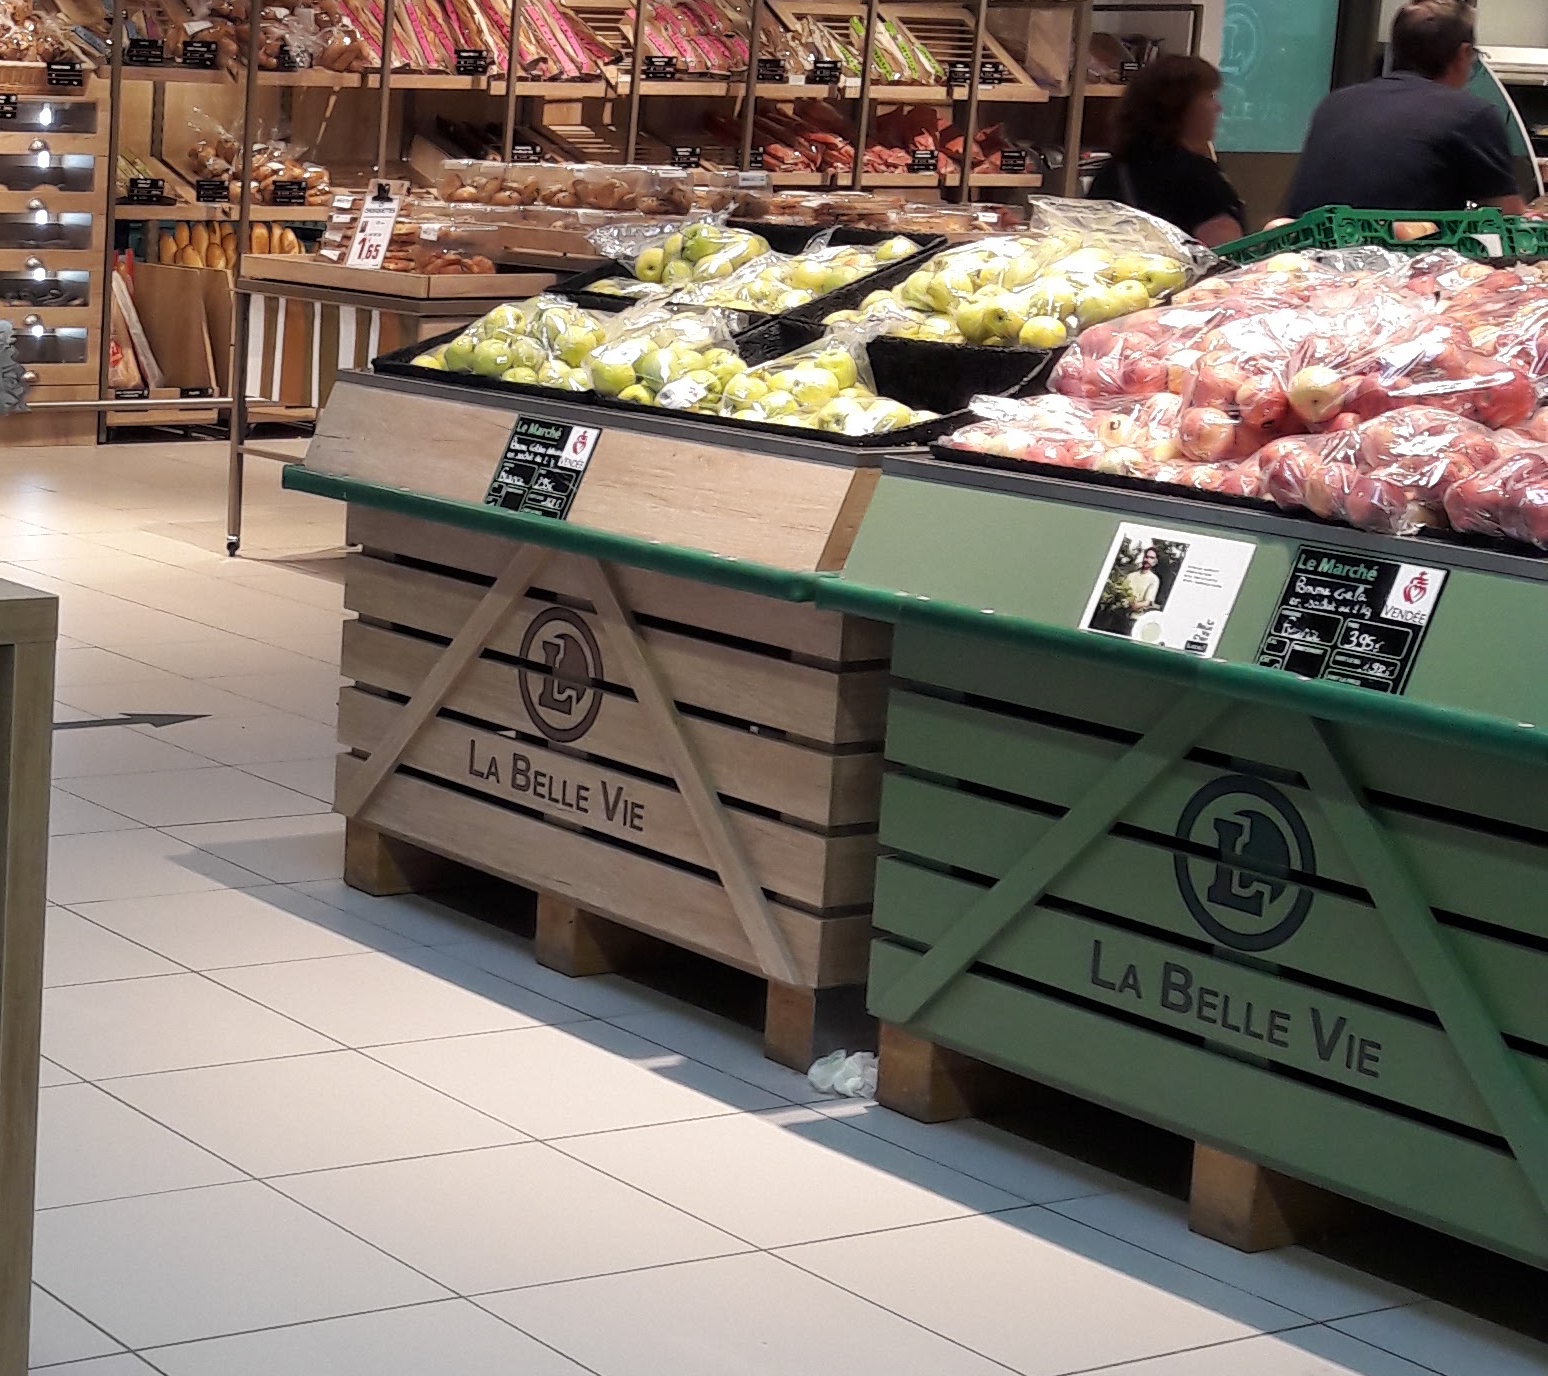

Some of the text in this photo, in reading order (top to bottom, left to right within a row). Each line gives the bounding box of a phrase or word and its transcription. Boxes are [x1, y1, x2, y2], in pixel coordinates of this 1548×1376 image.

[1297, 554, 1379, 581] Le Marché
[1383, 604, 1427, 625] VENDÉE
